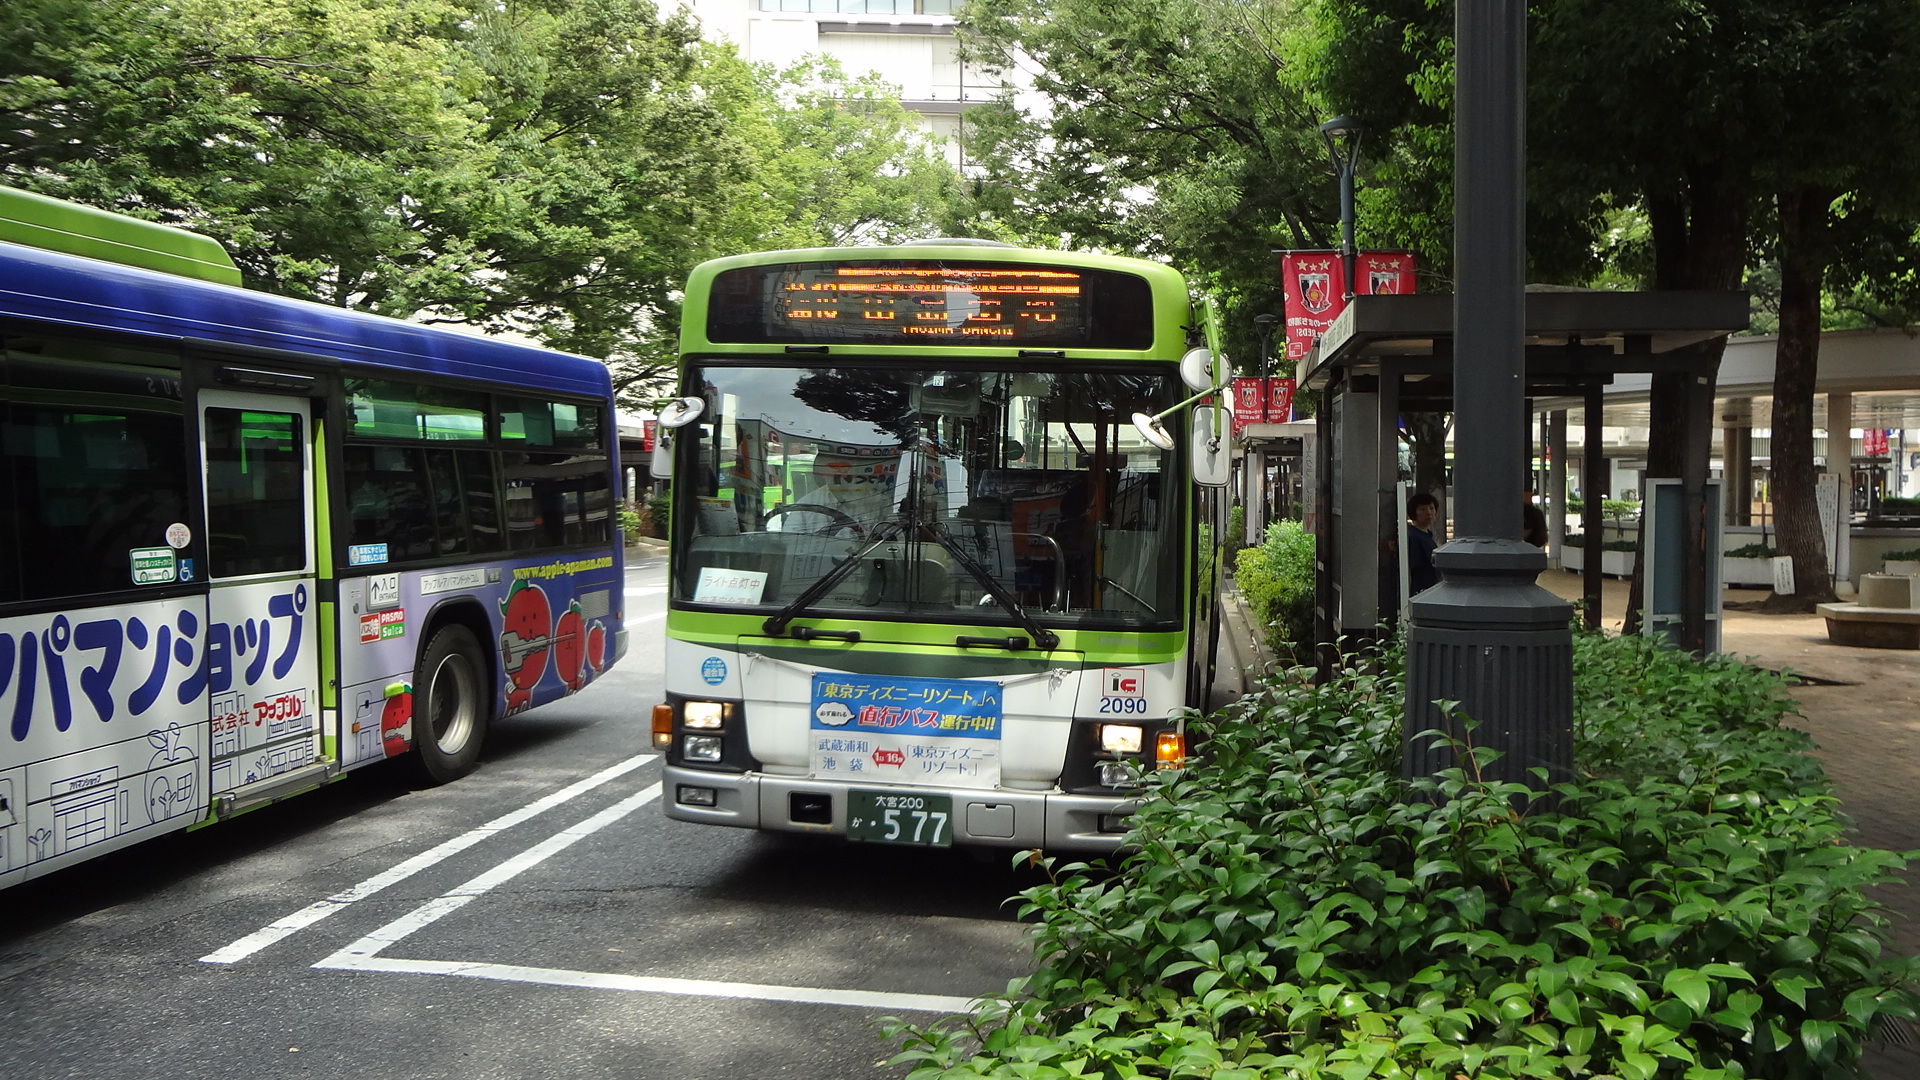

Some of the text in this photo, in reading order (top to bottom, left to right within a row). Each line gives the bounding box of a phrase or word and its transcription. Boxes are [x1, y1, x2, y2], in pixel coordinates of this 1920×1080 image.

[513, 557, 612, 580] www.apple-apaman.com
[381, 577, 396, 592] 入口
[704, 575, 761, 590] ライト点灯中
[381, 611, 404, 624] PASMO
[382, 626, 403, 638] Suica
[1099, 697, 1147, 714] 2090
[212, 694, 302, 733] 式会社 アップル
[818, 738, 868, 753] 武蔵浦和
[851, 816, 863, 828] か
